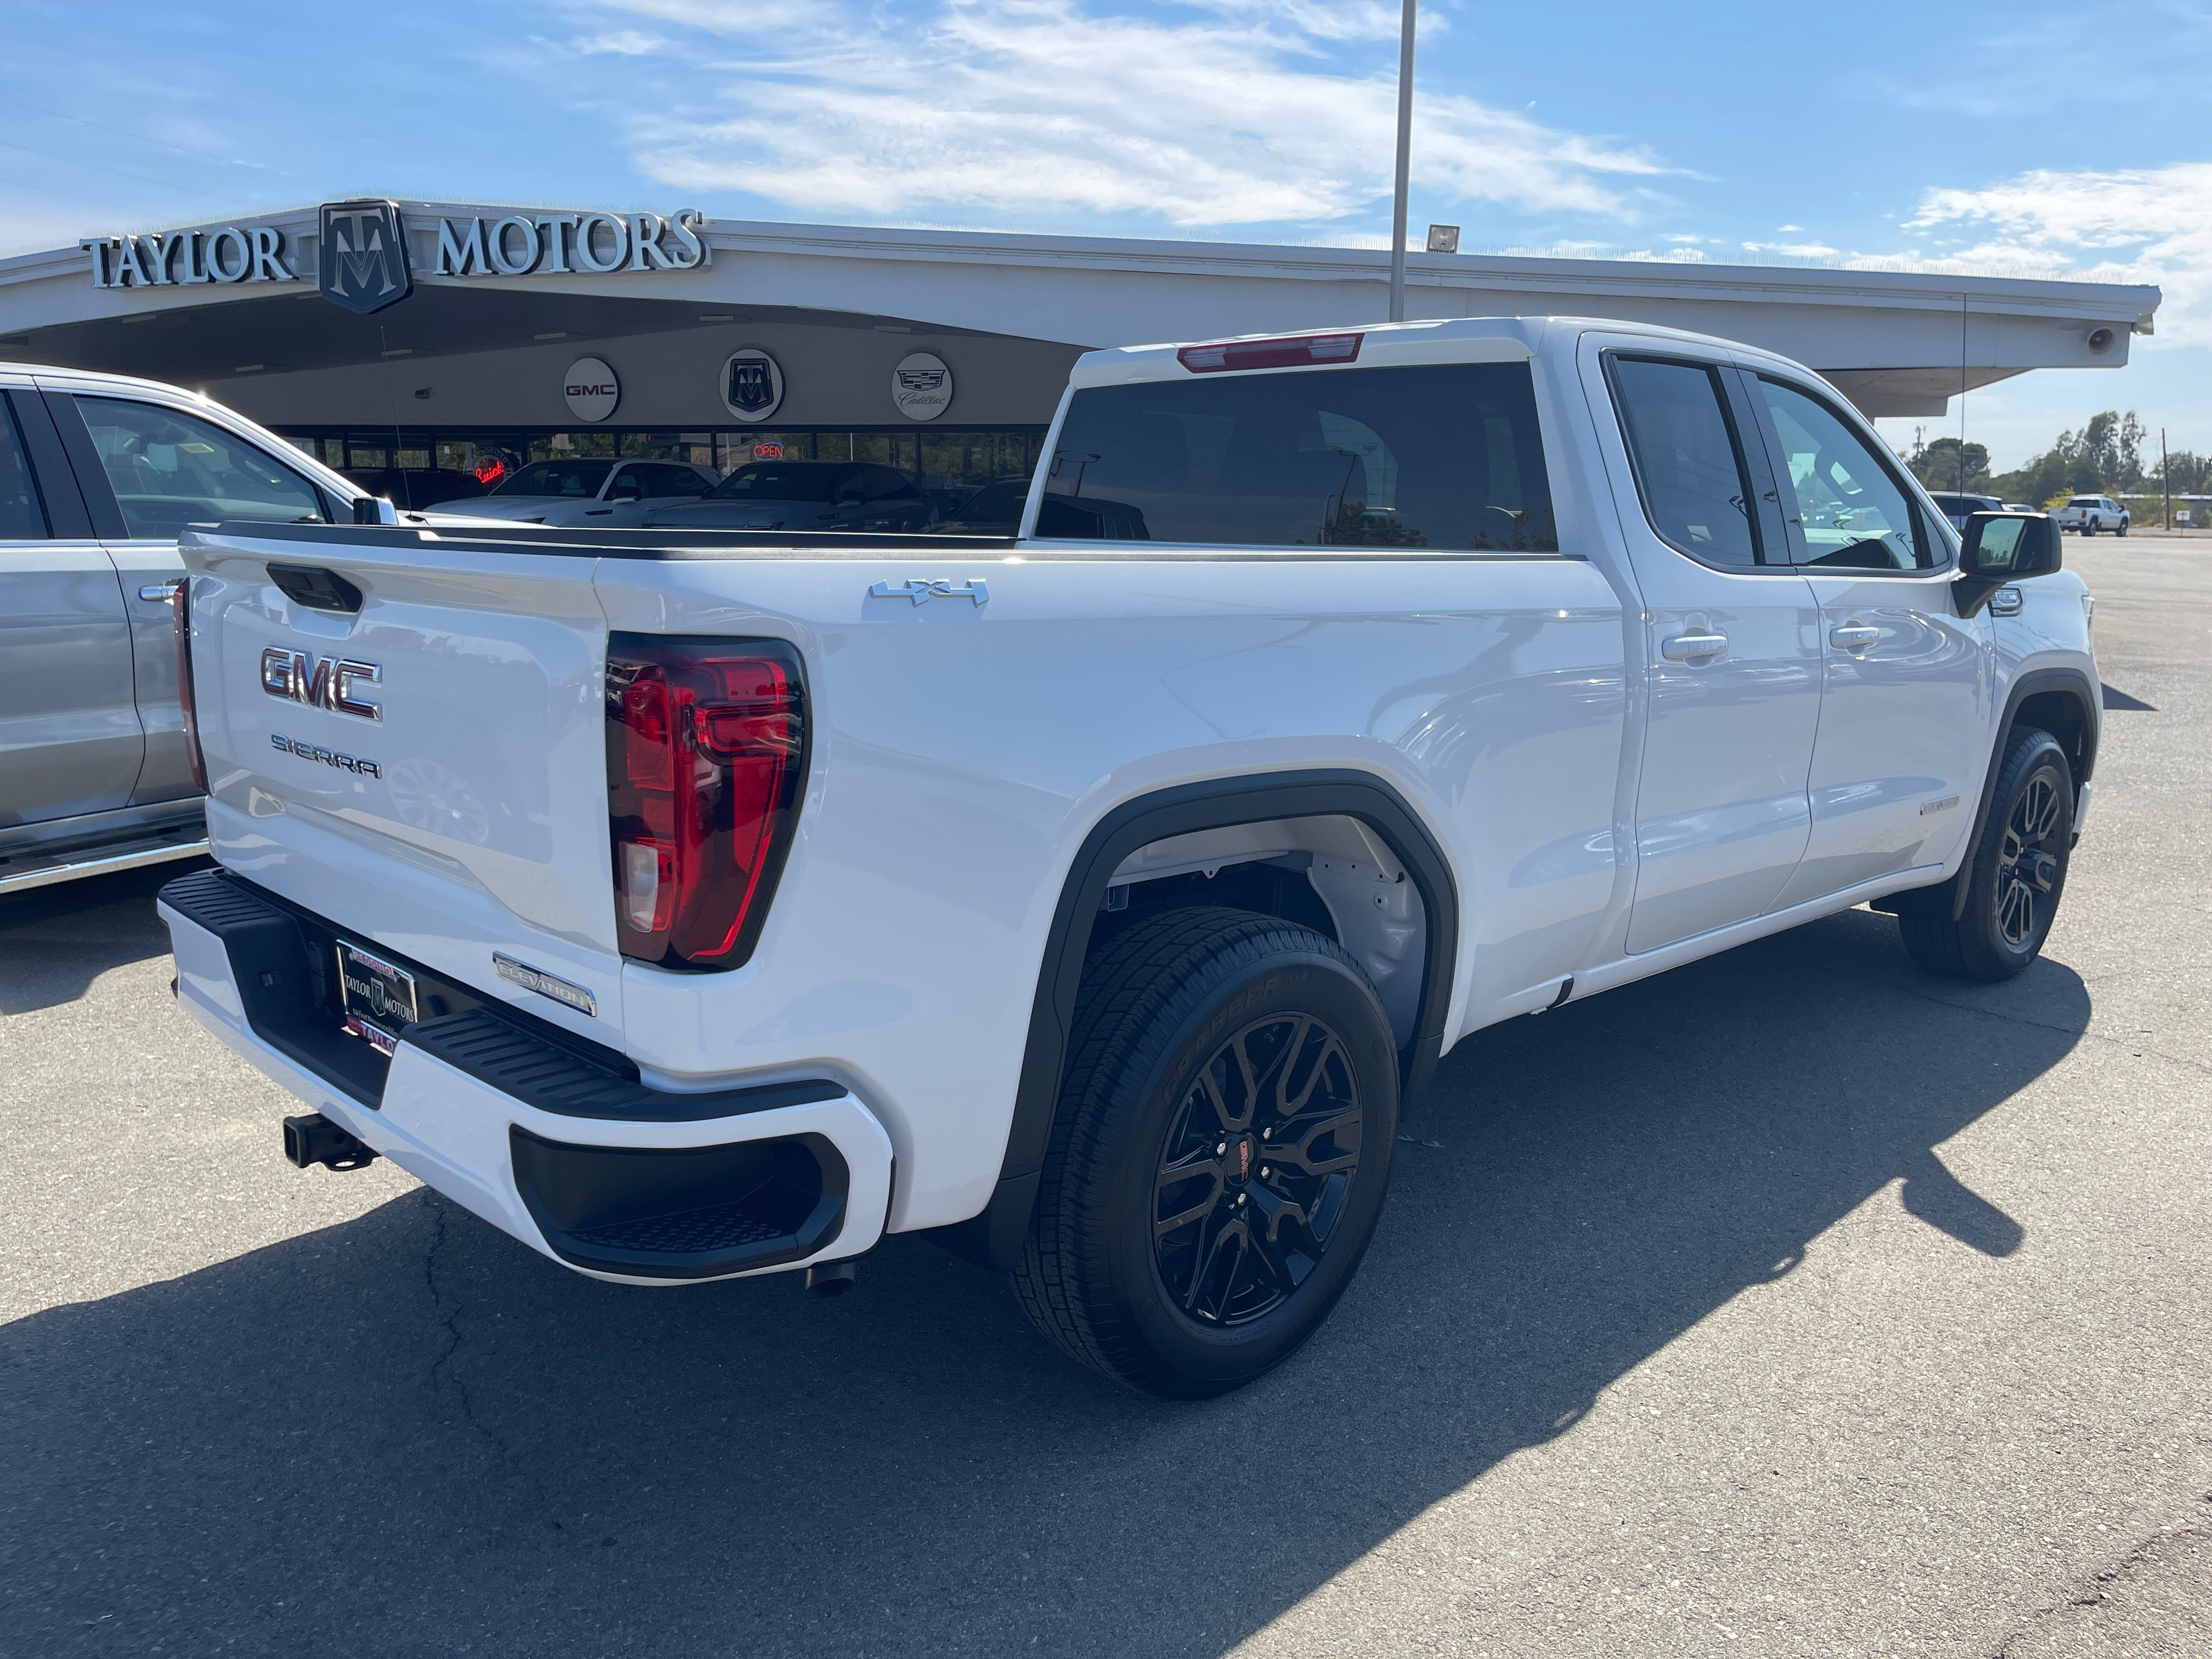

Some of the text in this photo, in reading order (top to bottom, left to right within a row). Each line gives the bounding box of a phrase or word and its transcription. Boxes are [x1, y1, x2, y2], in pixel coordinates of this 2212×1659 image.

[80, 227, 297, 289] TAYLOR
[433, 208, 703, 276] MOTORS
[566, 385, 616, 396] GMC
[898, 392, 945, 407] Cadillac
[754, 445, 784, 458] OPEN
[261, 645, 383, 722] GMC
[271, 732, 382, 780] SIERRA
[352, 949, 393, 975] REDDING
[345, 974, 372, 999] TAYLOR
[385, 996, 414, 1023] MOTORS
[499, 962, 585, 1008] ELEVATION
[1239, 1141, 1249, 1182] GMC
